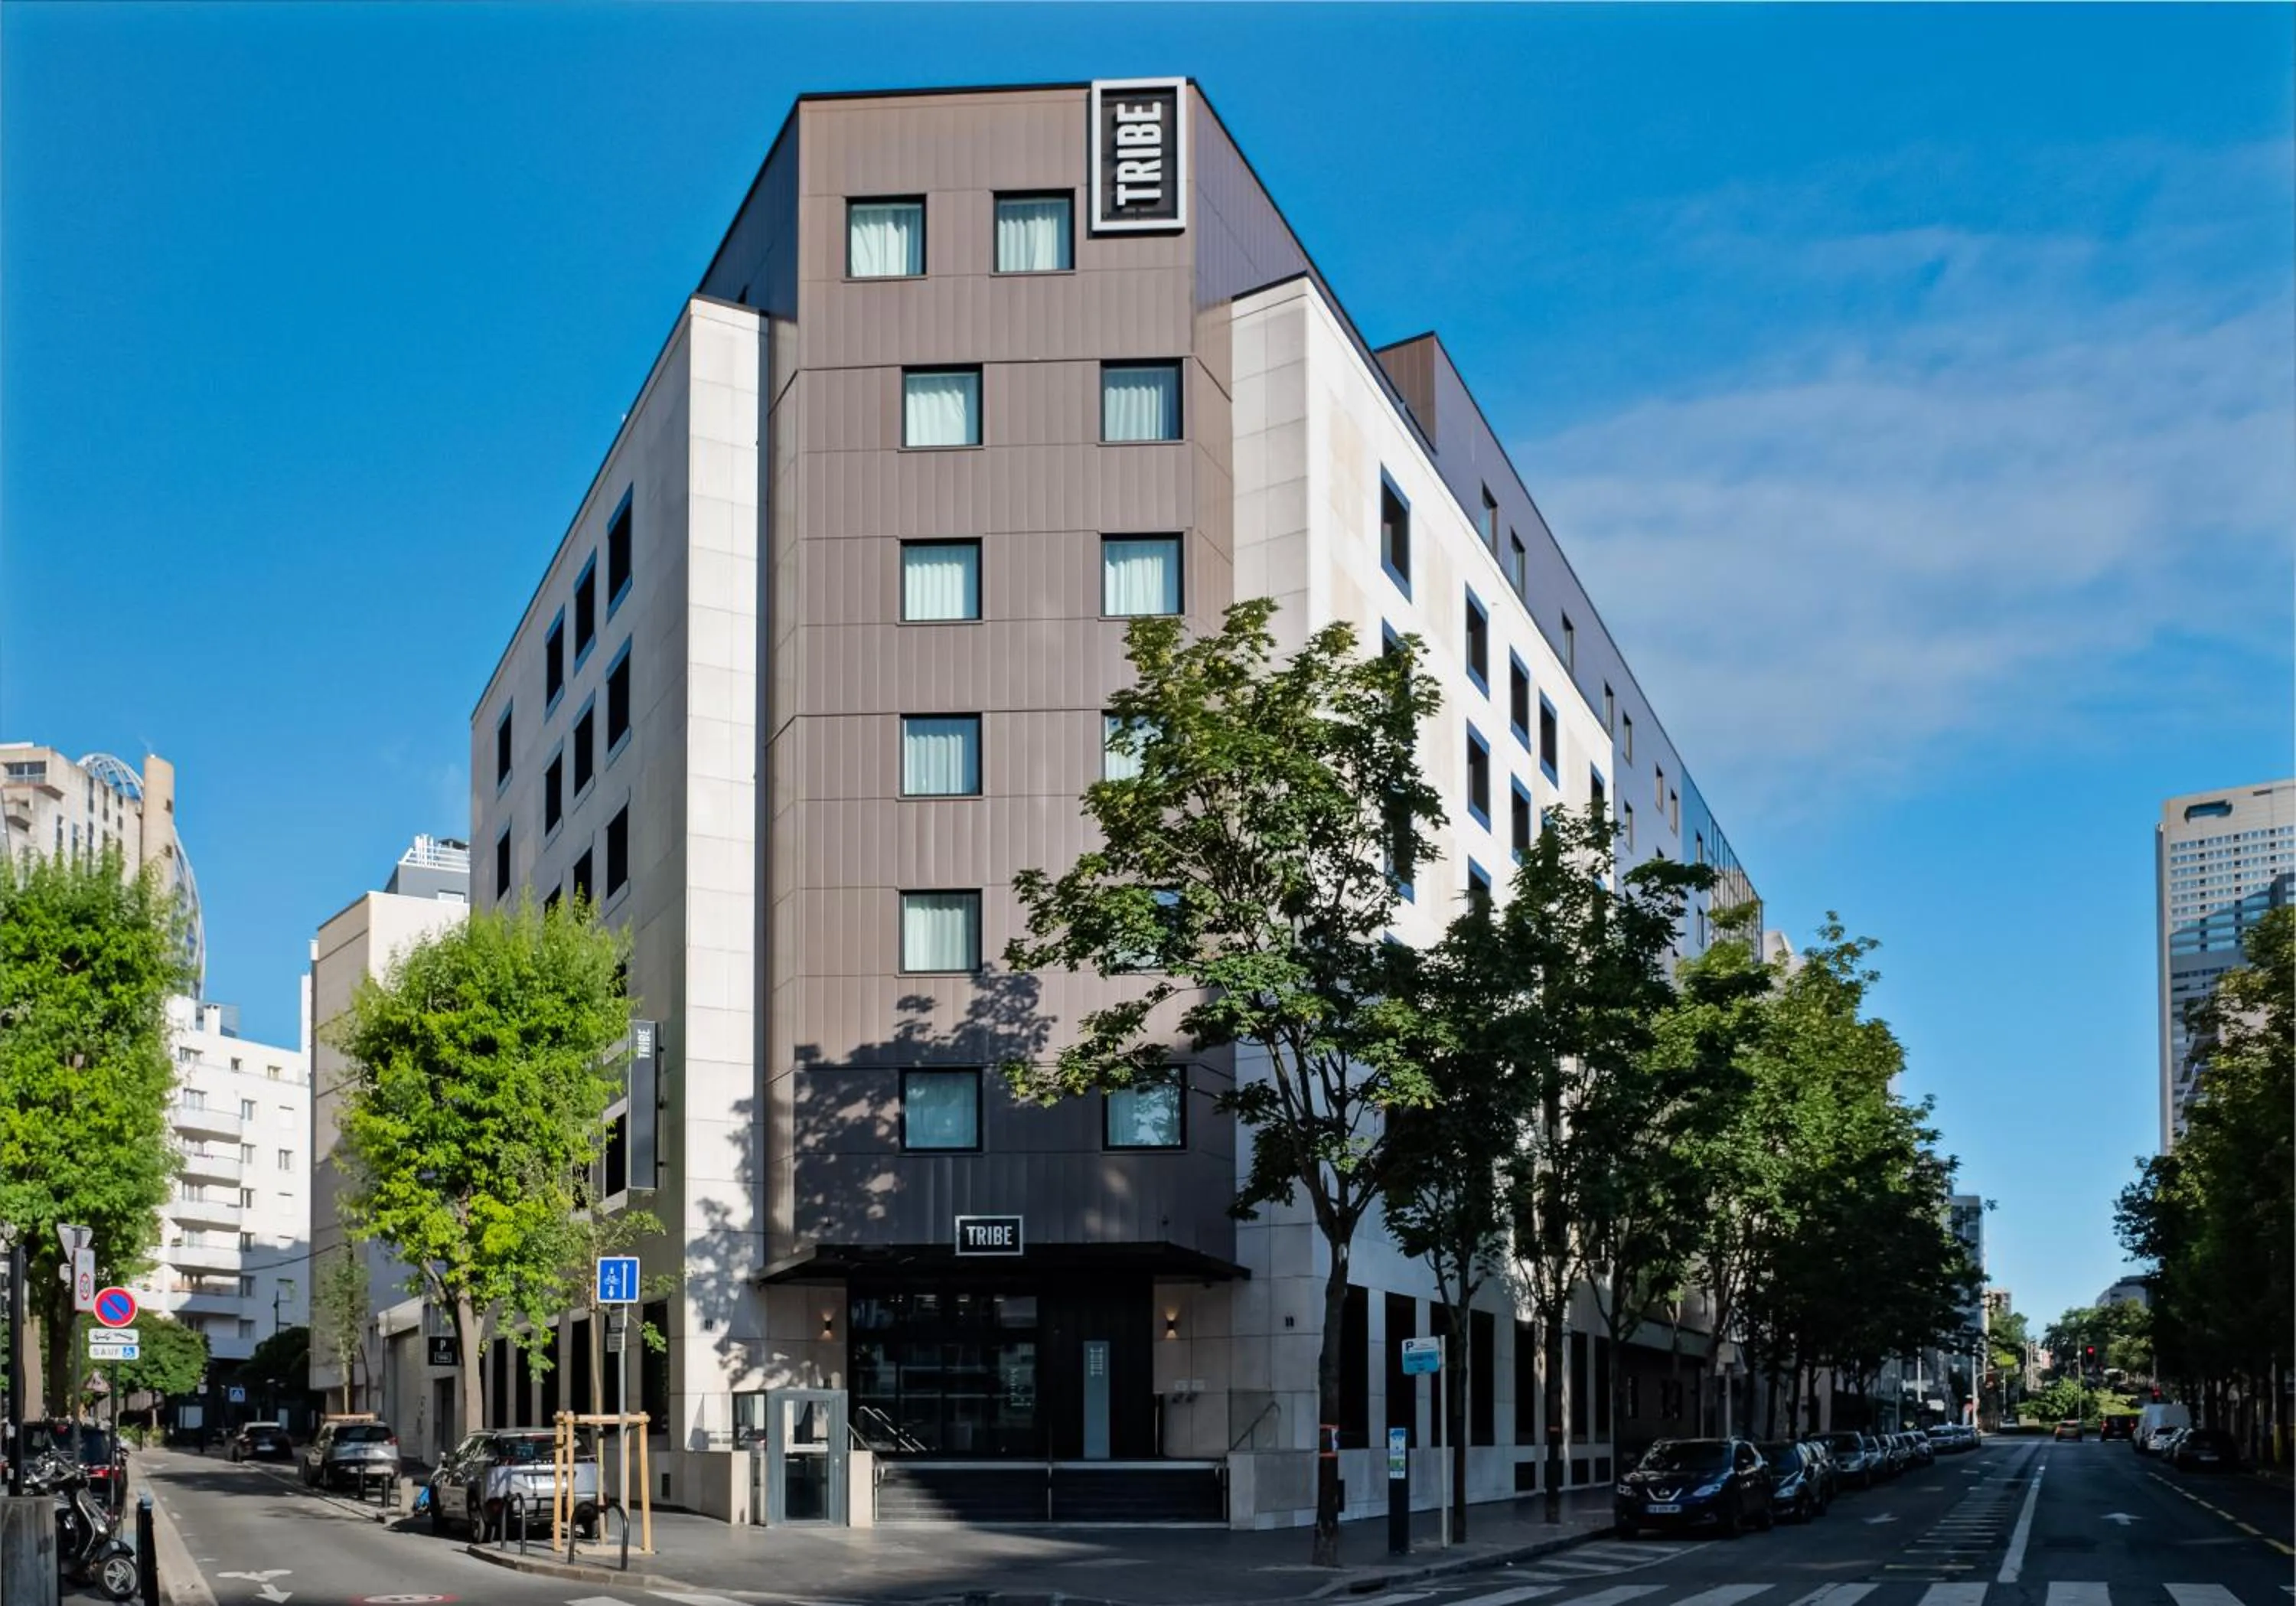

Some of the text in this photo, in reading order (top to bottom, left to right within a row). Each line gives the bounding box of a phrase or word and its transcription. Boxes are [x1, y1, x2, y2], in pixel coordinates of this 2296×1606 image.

[1117, 101, 1162, 206] TRIBE
[966, 1226, 1013, 1245] TRIBE
[1405, 1340, 1414, 1352] P
